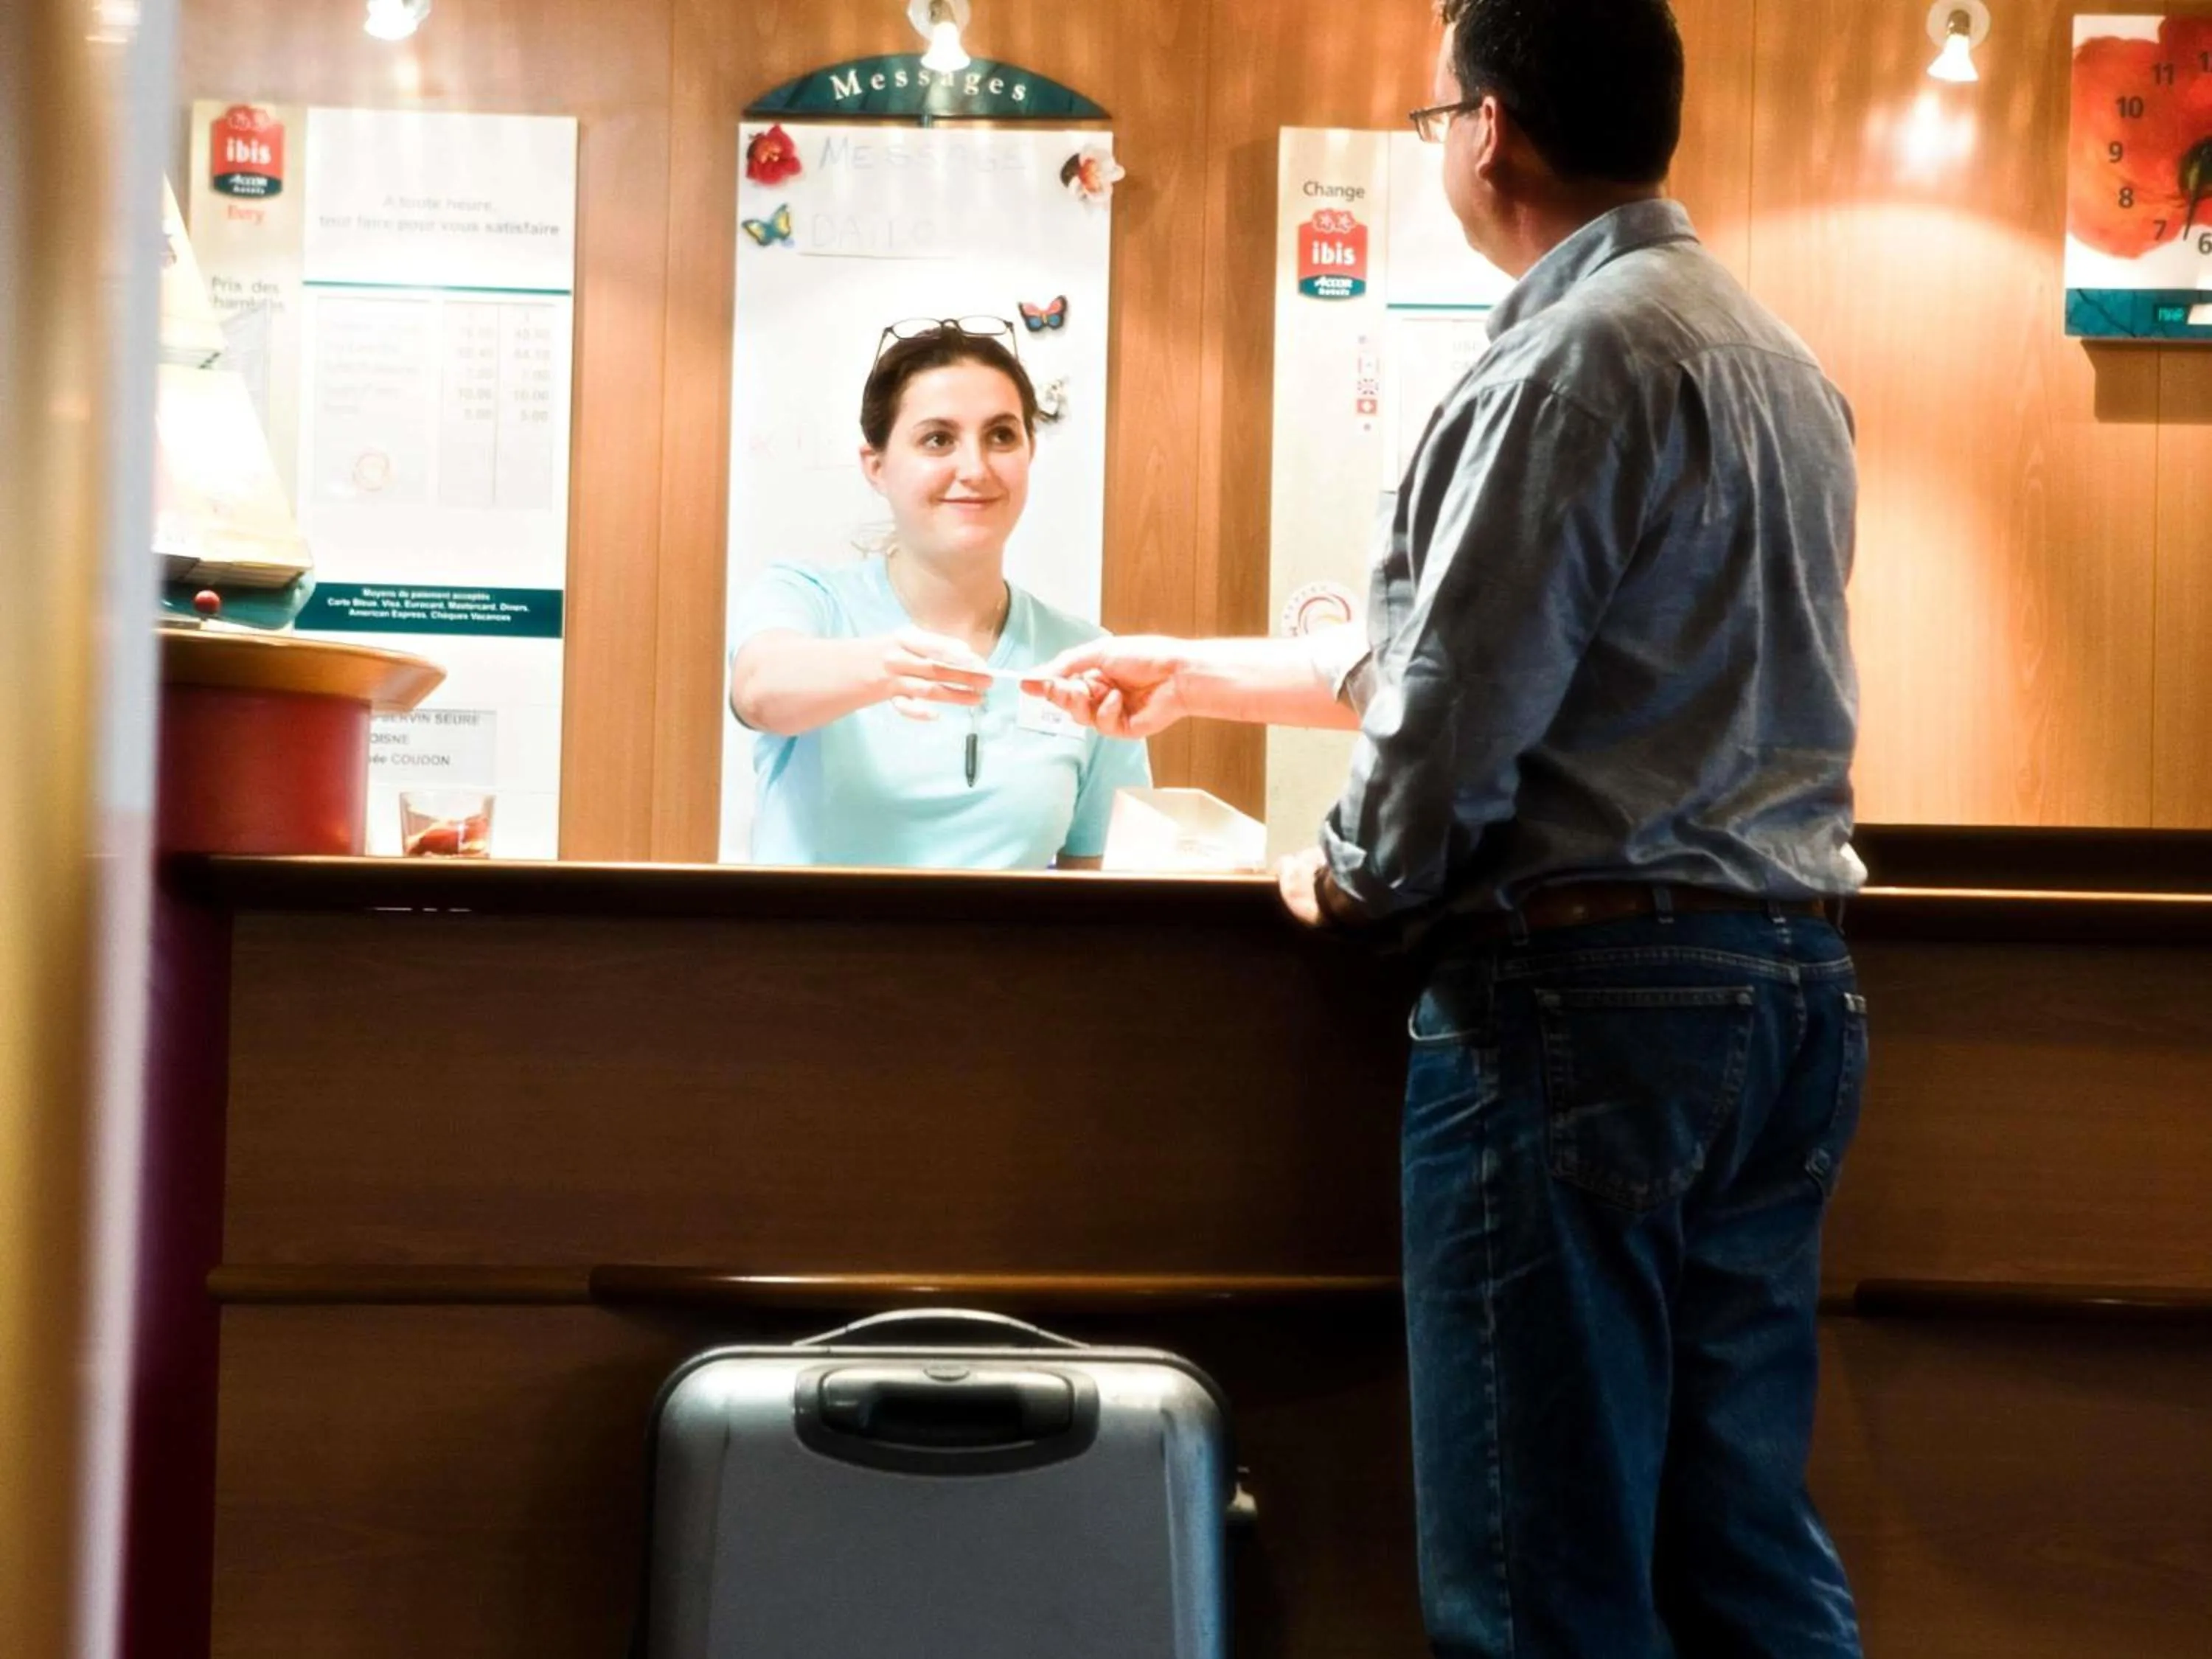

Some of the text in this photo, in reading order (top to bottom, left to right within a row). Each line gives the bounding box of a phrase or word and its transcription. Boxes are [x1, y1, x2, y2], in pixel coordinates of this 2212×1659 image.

[2199, 52, 2212, 73] 1
[830, 69, 1026, 101] Messages
[2152, 63, 2174, 86] 11
[2117, 96, 2144, 119] 10
[226, 138, 272, 165] ibis
[2109, 141, 2124, 163] 9
[1303, 181, 1366, 202] Change
[2118, 187, 2134, 209] 8
[441, 220, 479, 233] vous
[485, 220, 560, 236] satisfaire
[2153, 220, 2167, 240] 7
[1312, 240, 1355, 265] ibis
[2198, 233, 2212, 255] 6
[212, 276, 279, 293] Prix des
[327, 598, 350, 607] Carte
[362, 588, 397, 598] Moyens
[398, 589, 409, 599] de
[411, 590, 451, 601] paiement
[349, 608, 390, 618] American
[471, 612, 511, 622] Vacances
[435, 712, 480, 726] SEURE
[391, 754, 451, 766] COUDON
